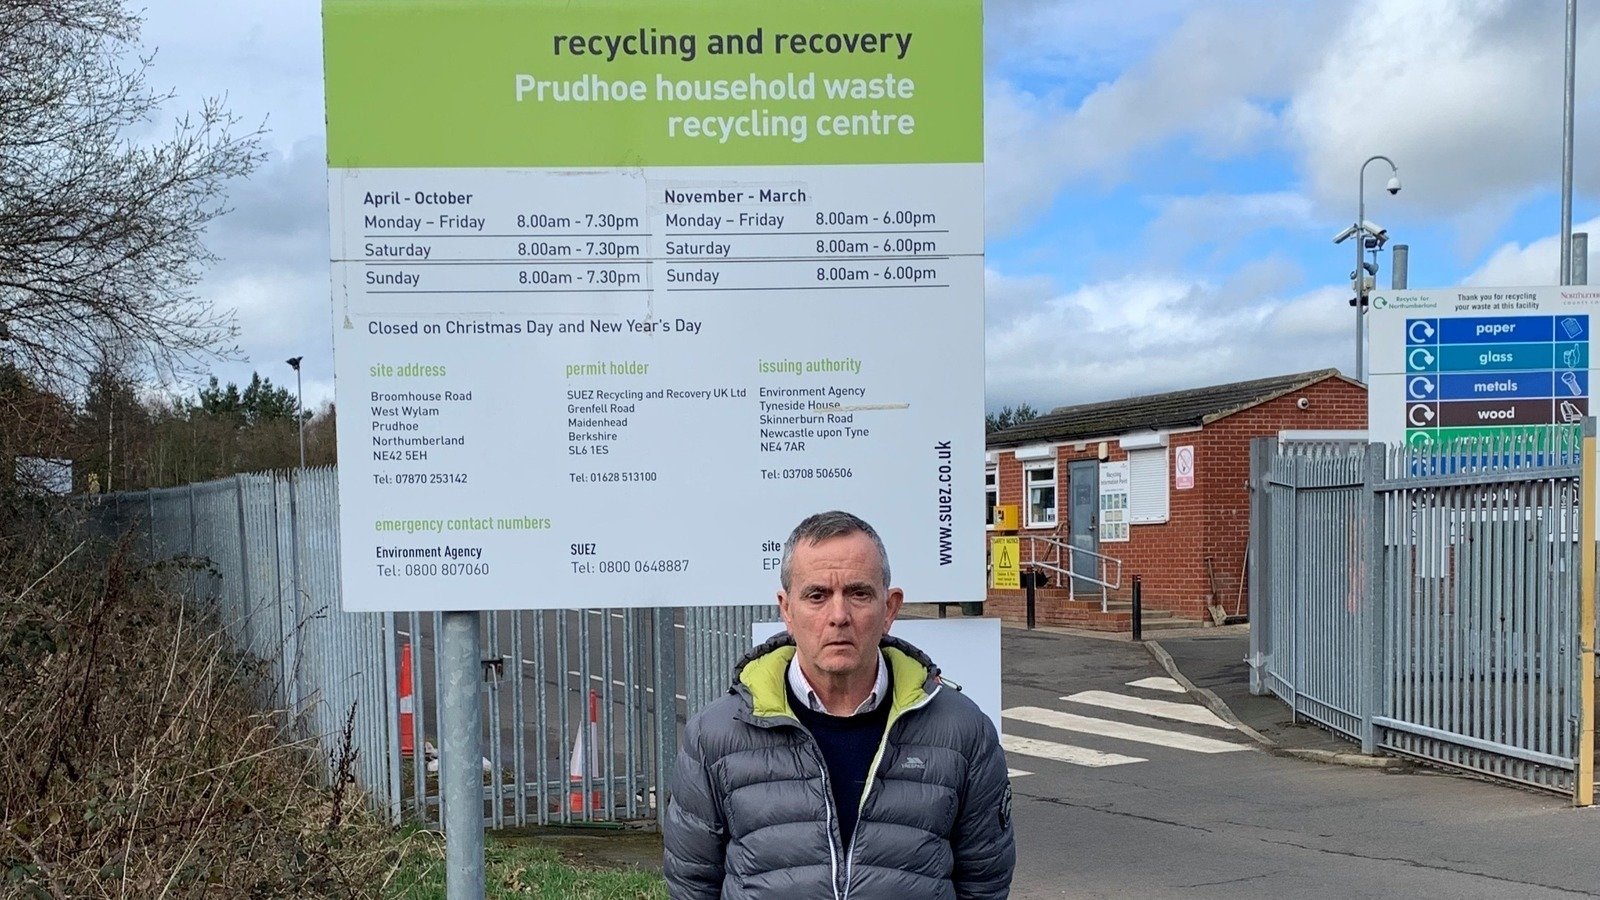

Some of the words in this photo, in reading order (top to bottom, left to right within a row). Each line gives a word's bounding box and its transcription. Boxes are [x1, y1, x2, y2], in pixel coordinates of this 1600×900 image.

[554, 28, 695, 62] recycling
[708, 28, 762, 54] and
[776, 33, 912, 59] recovery
[516, 74, 646, 101] Prudhoe
[657, 73, 815, 100] household
[824, 74, 914, 99] waste
[669, 109, 807, 143] recycling
[817, 110, 914, 135] centre
[363, 191, 401, 208] April
[414, 190, 473, 205] October
[664, 189, 744, 204] November
[759, 188, 806, 203] March
[364, 214, 422, 232] Monday
[439, 214, 486, 232] Friday
[516, 214, 571, 228] 8.00am
[585, 213, 639, 231] 7.30pm
[665, 213, 722, 230] Monday
[739, 212, 785, 230] Friday
[815, 211, 869, 226] 8.00am
[882, 210, 936, 228] 6.00pm
[364, 242, 433, 260] Saturday
[517, 242, 572, 257] 8.00am
[586, 241, 641, 259] 7.30pm
[665, 240, 731, 258] Saturday
[816, 239, 869, 254] 8.00am
[883, 238, 937, 256] 6.00pm
[365, 270, 420, 288] Sunday
[518, 270, 572, 285] 8.00am
[586, 269, 640, 287] 7.30pm
[666, 268, 720, 285] Sunday
[816, 267, 869, 281] 8.00am
[883, 265, 936, 283] 6.00pm
[1457, 293, 1478, 301] Thank
[1480, 294, 1492, 302] you
[1505, 292, 1537, 301] recycling
[1454, 304, 1469, 312] your
[1501, 302, 1514, 310] this
[1516, 301, 1540, 310] facility
[368, 320, 418, 335] Closed
[423, 323, 441, 335] on
[445, 320, 522, 334] Christmas
[526, 319, 554, 337] Day
[558, 319, 585, 334] and
[590, 319, 623, 333] New
[626, 319, 672, 333] Year's
[675, 318, 702, 335] Day
[1476, 323, 1516, 336] paper
[1479, 351, 1513, 365] glass
[369, 362, 394, 378] site
[396, 362, 447, 377] address
[566, 360, 607, 379] permit
[609, 360, 650, 376] holder
[758, 358, 803, 376] issuing
[805, 357, 862, 375] authority
[759, 386, 826, 398] Environment
[827, 385, 866, 399] Agency
[1474, 379, 1518, 392] metals
[370, 391, 442, 402] Broomhouse
[444, 390, 472, 401] Road
[567, 389, 594, 400] SUEZ
[596, 389, 644, 402] Recycling
[645, 389, 664, 399] and
[666, 388, 712, 401] Recovery
[713, 387, 729, 398] UK
[730, 388, 747, 398] Ltd
[370, 406, 399, 417] West
[401, 406, 440, 419] Wylam
[567, 403, 608, 414] Grenfell
[610, 403, 635, 414] Road
[759, 400, 806, 413] Tyneside
[1477, 406, 1515, 420] wood
[372, 421, 419, 432] Prudhoe
[568, 417, 628, 428] Maidenhead
[759, 414, 825, 425] Skinnerburn
[827, 413, 854, 424] Road
[568, 431, 618, 442] Berkshire
[760, 427, 815, 439] Newcastle
[816, 429, 843, 440] upon
[844, 426, 870, 439] Tyne
[372, 435, 465, 447] Northumberland
[760, 441, 782, 452] NE4
[784, 441, 806, 452] 7AR
[373, 450, 403, 461] NE42
[405, 450, 428, 461] 5EH
[568, 445, 588, 456] SL6
[590, 444, 609, 455] 1ES
[372, 474, 393, 485] Tel:
[395, 473, 428, 485] 07870
[429, 473, 468, 484] 253142
[569, 472, 588, 483] Tel:
[590, 472, 620, 483] 01628
[621, 471, 657, 482] 513100
[760, 469, 780, 480] Tel:
[782, 468, 814, 479] 03708
[815, 467, 853, 479] 506506
[934, 440, 952, 566] www.suez.co.uk
[375, 519, 444, 535] emergency
[446, 516, 494, 531] contact
[496, 515, 551, 530] numbers
[376, 546, 442, 559] Environment
[444, 545, 483, 561] Agency
[570, 543, 597, 556] SUEZ
[761, 539, 781, 552] site
[376, 564, 401, 577] Tel:
[405, 563, 438, 577] 0800
[441, 562, 490, 576] 807060
[570, 561, 595, 574] Tel:
[599, 560, 631, 574] 0800
[634, 559, 690, 573] 0648887
